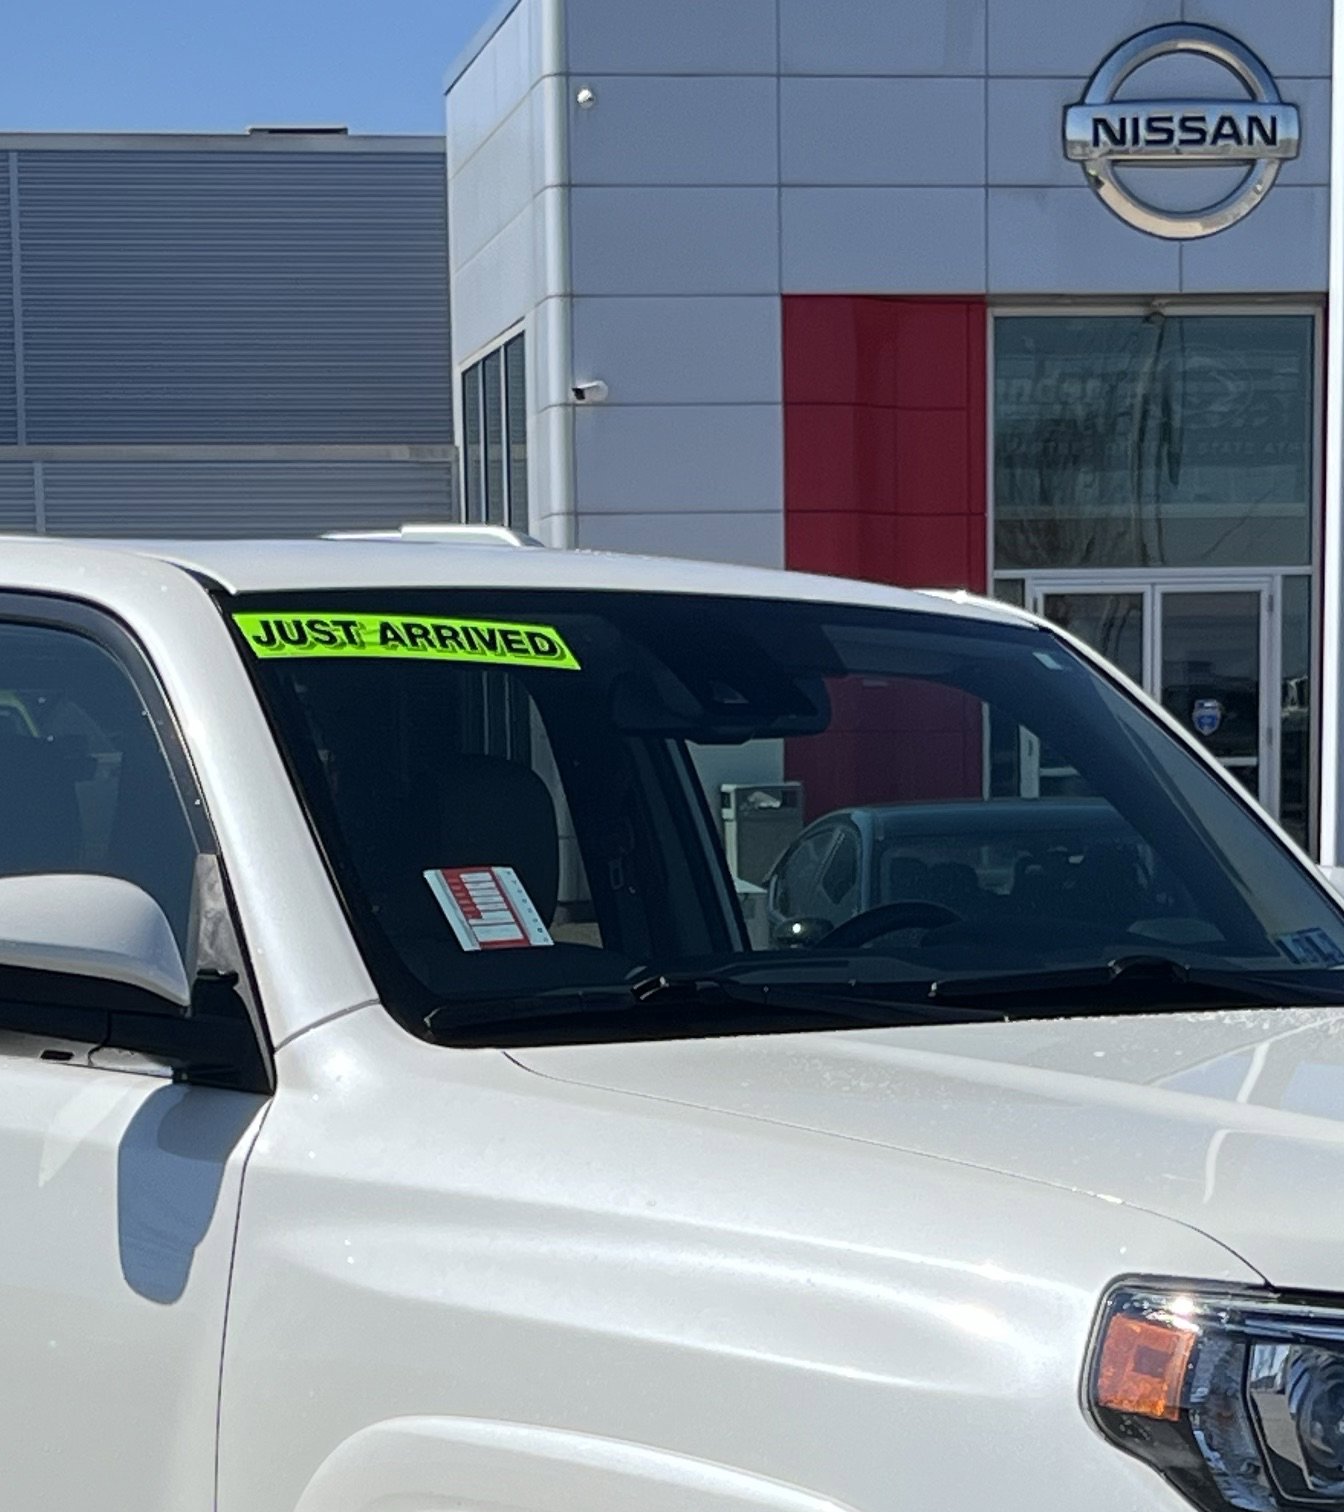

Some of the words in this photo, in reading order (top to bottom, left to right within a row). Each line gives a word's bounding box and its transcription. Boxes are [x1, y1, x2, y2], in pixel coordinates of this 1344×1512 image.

[1091, 114, 1279, 149] NISSAN
[253, 619, 360, 650] JUST
[377, 620, 565, 658] ARRIVED
